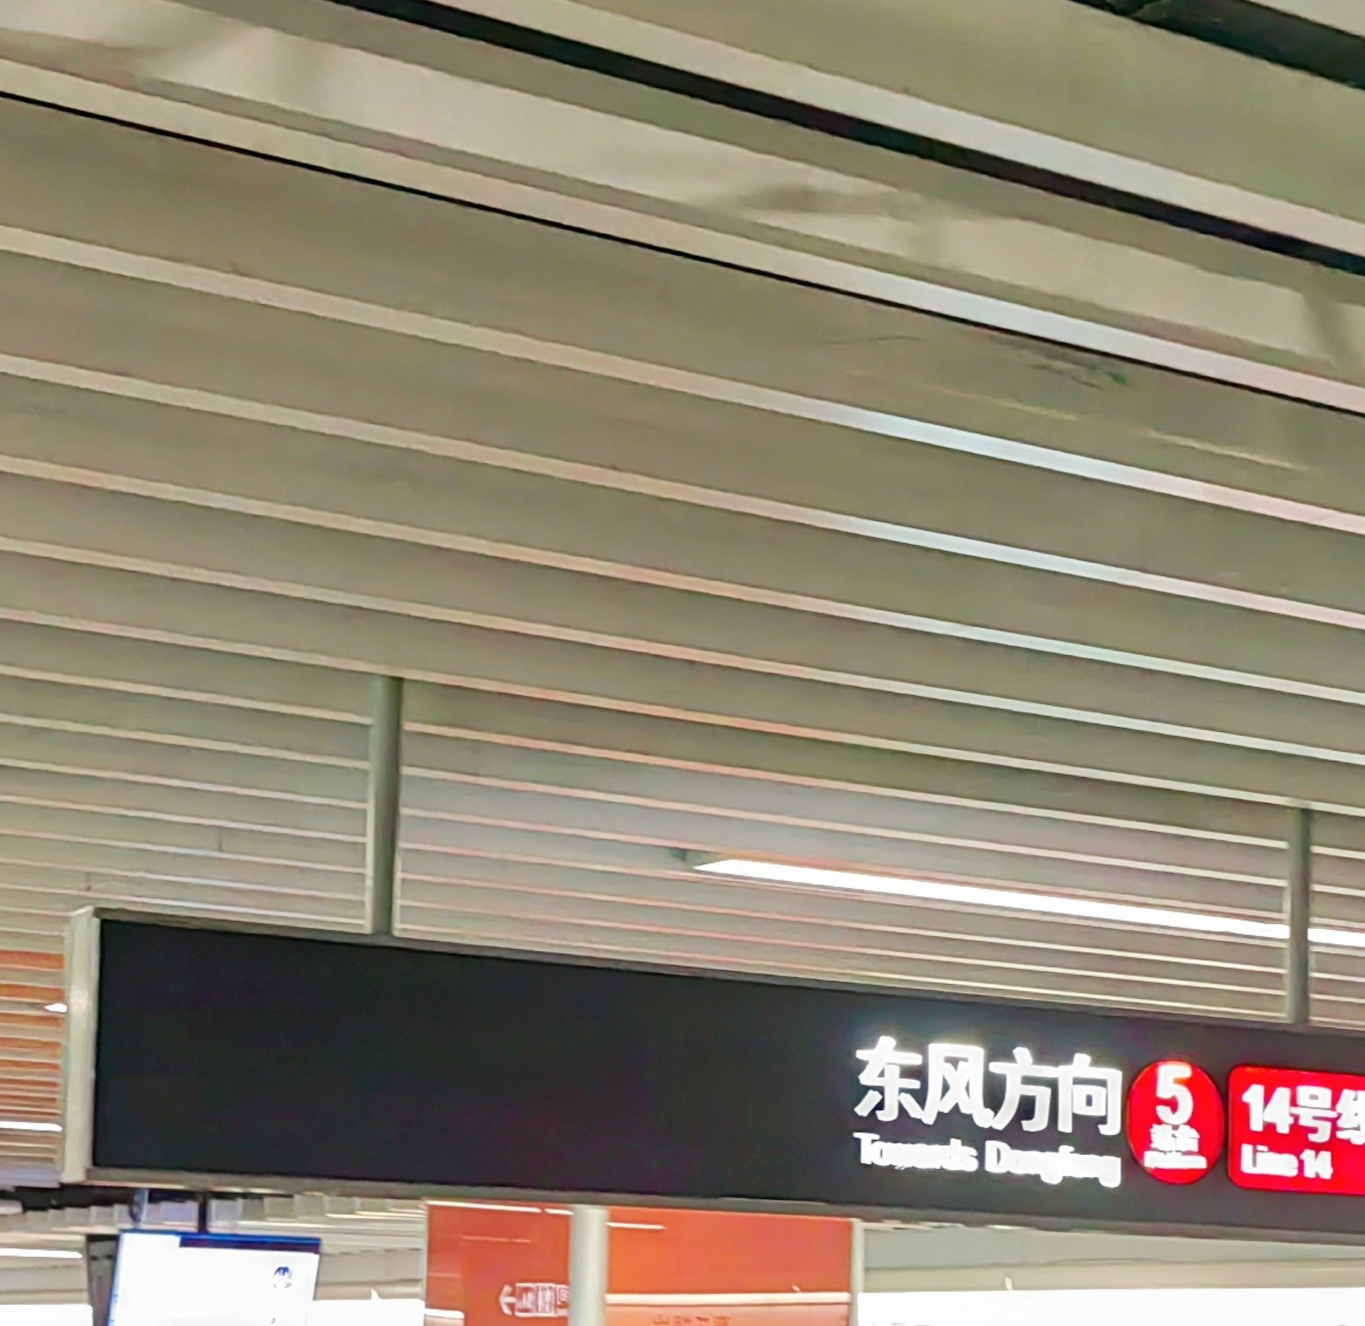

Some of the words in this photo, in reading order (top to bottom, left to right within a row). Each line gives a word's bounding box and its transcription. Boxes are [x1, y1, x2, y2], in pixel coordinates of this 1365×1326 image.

[853, 1035, 1123, 1136] 东风方向
[1156, 1064, 1194, 1125] 5
[1241, 1143, 1298, 1178] Line
